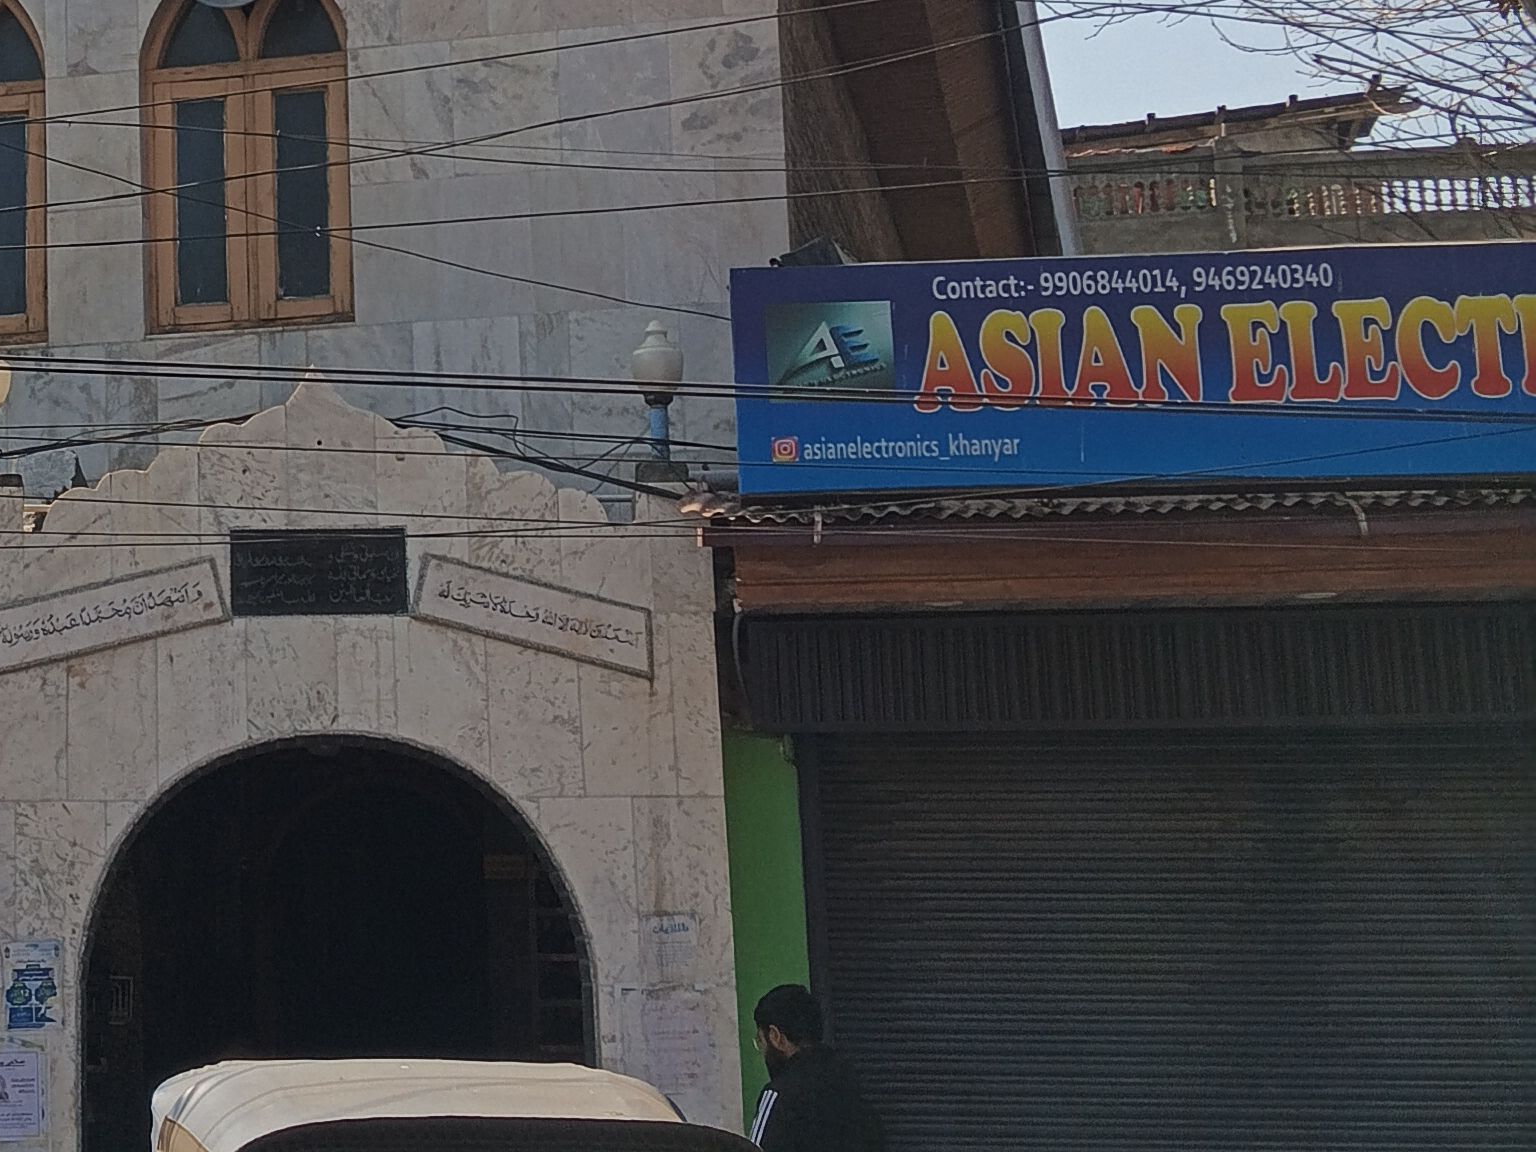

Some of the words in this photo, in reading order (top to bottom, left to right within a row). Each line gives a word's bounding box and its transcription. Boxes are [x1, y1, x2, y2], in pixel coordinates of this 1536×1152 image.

[932, 275, 1034, 300] Contact:-
[1040, 268, 1187, 298] 9906844014,
[1193, 262, 1333, 291] 9469240340
[913, 304, 1203, 413] ASIAN
[803, 433, 1020, 462] asianelectronics_khanyar
